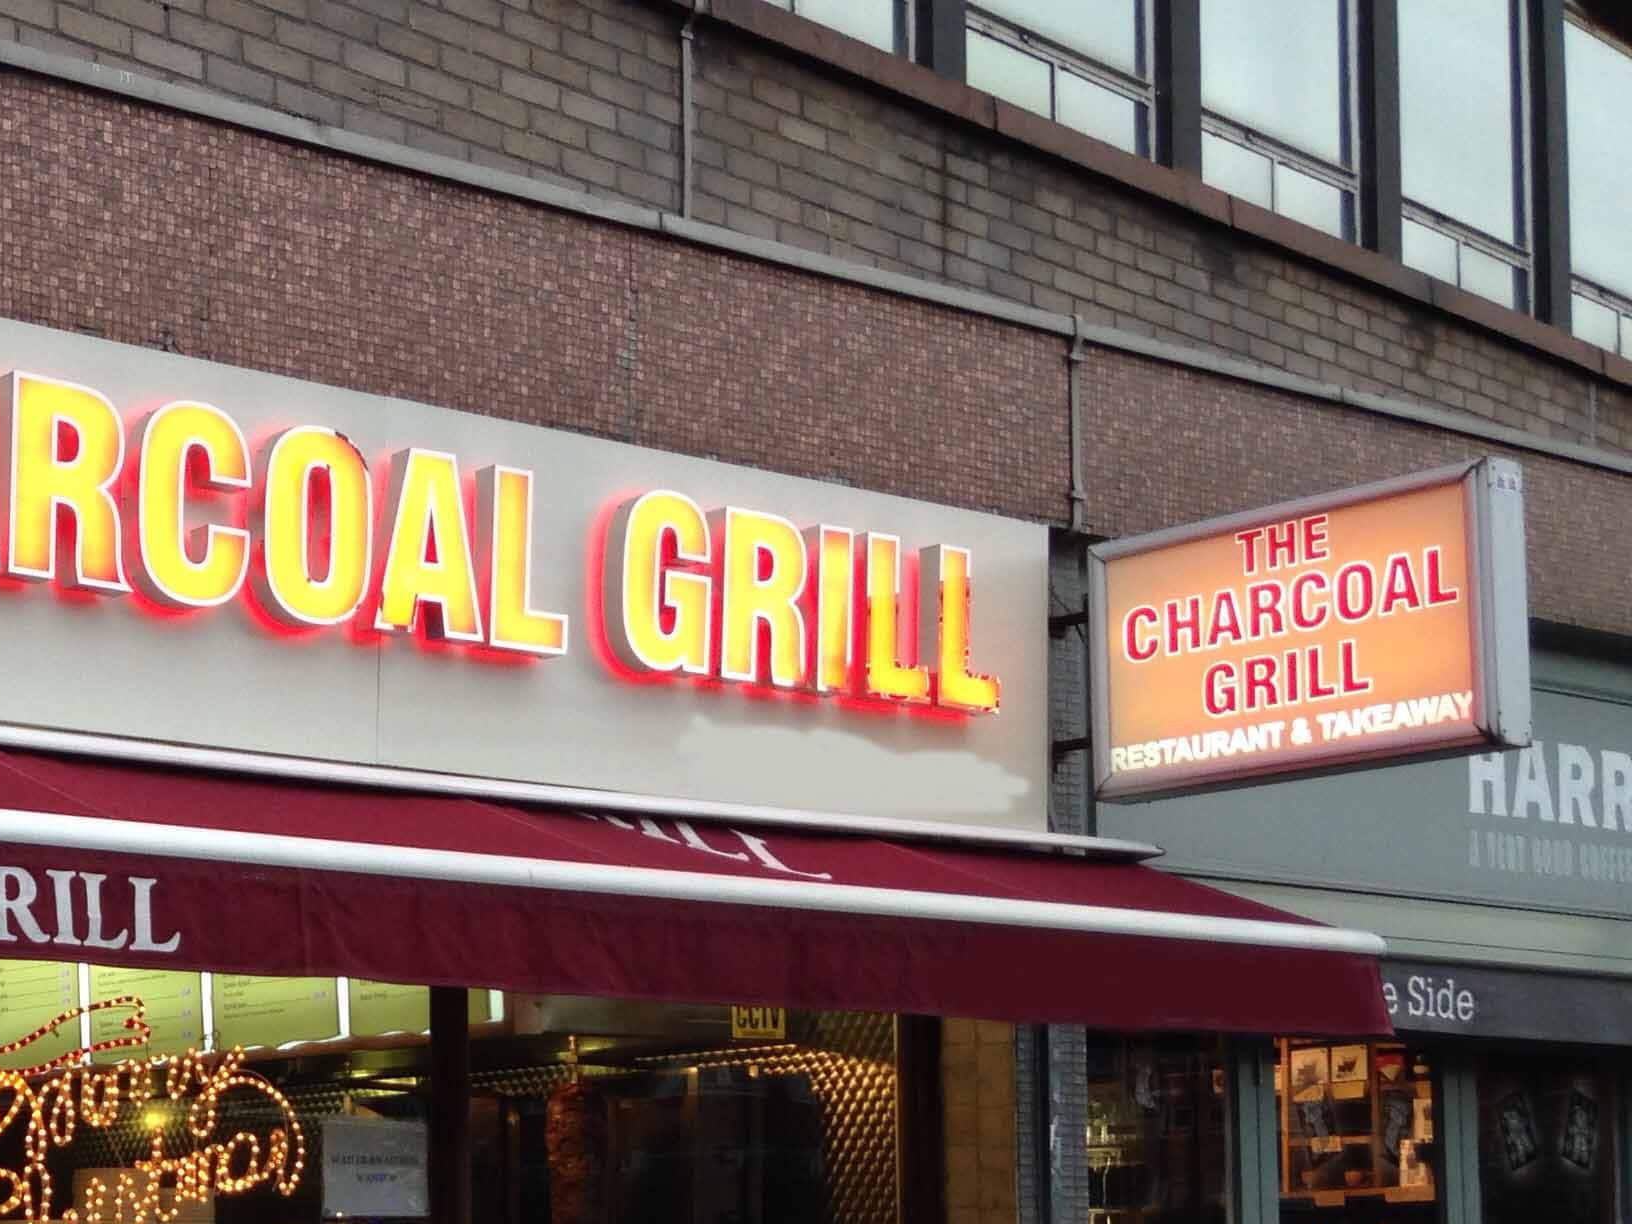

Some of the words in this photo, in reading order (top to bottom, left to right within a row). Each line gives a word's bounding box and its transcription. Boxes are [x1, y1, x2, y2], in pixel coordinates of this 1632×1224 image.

[1235, 514, 1329, 575] THE
[606, 489, 1001, 716] GRILL
[1124, 547, 1459, 662] CHARCOAL
[1204, 640, 1371, 716] GRILL
[1111, 719, 1285, 775] RESTAURANT
[1290, 718, 1313, 745] &
[1316, 691, 1473, 741] TAKEAWAY
[1408, 975, 1474, 1020] Side
